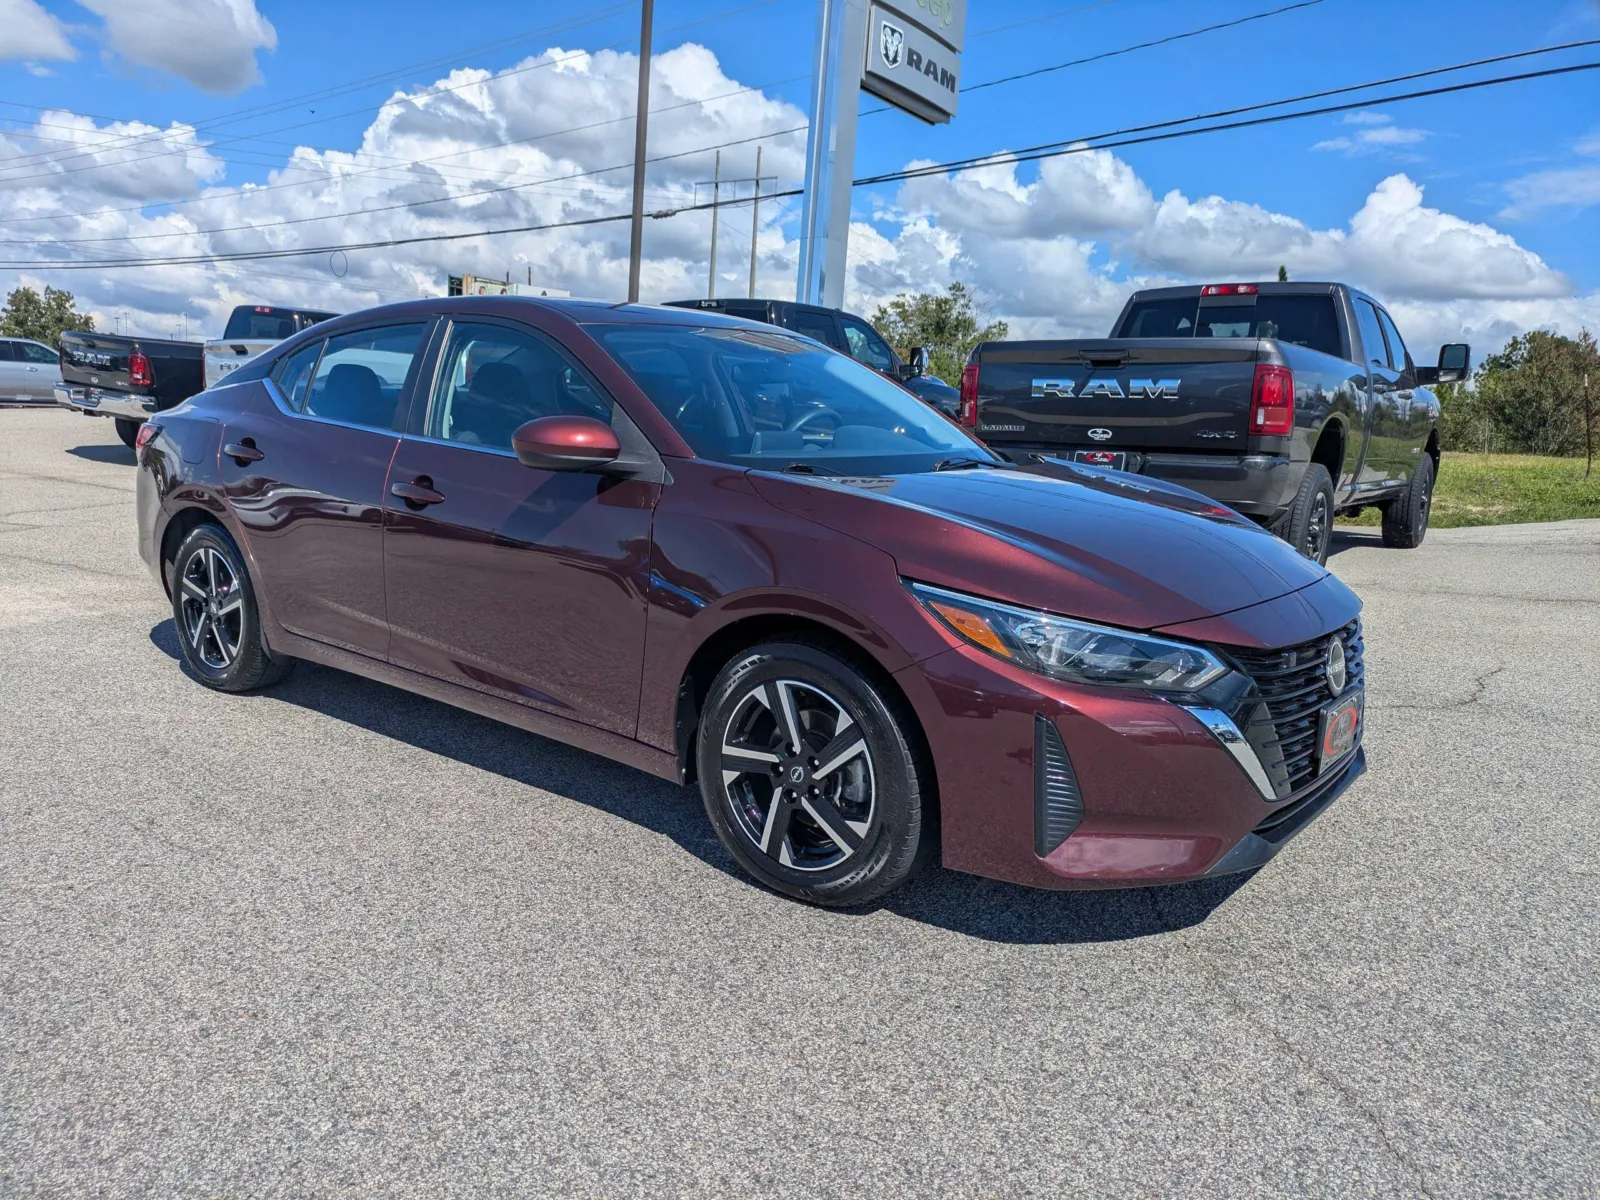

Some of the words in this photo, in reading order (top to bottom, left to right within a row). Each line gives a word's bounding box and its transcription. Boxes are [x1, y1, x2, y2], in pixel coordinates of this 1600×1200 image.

[906, 47, 956, 94] RAM
[73, 351, 110, 366] RAM
[1031, 378, 1181, 399] RAM
